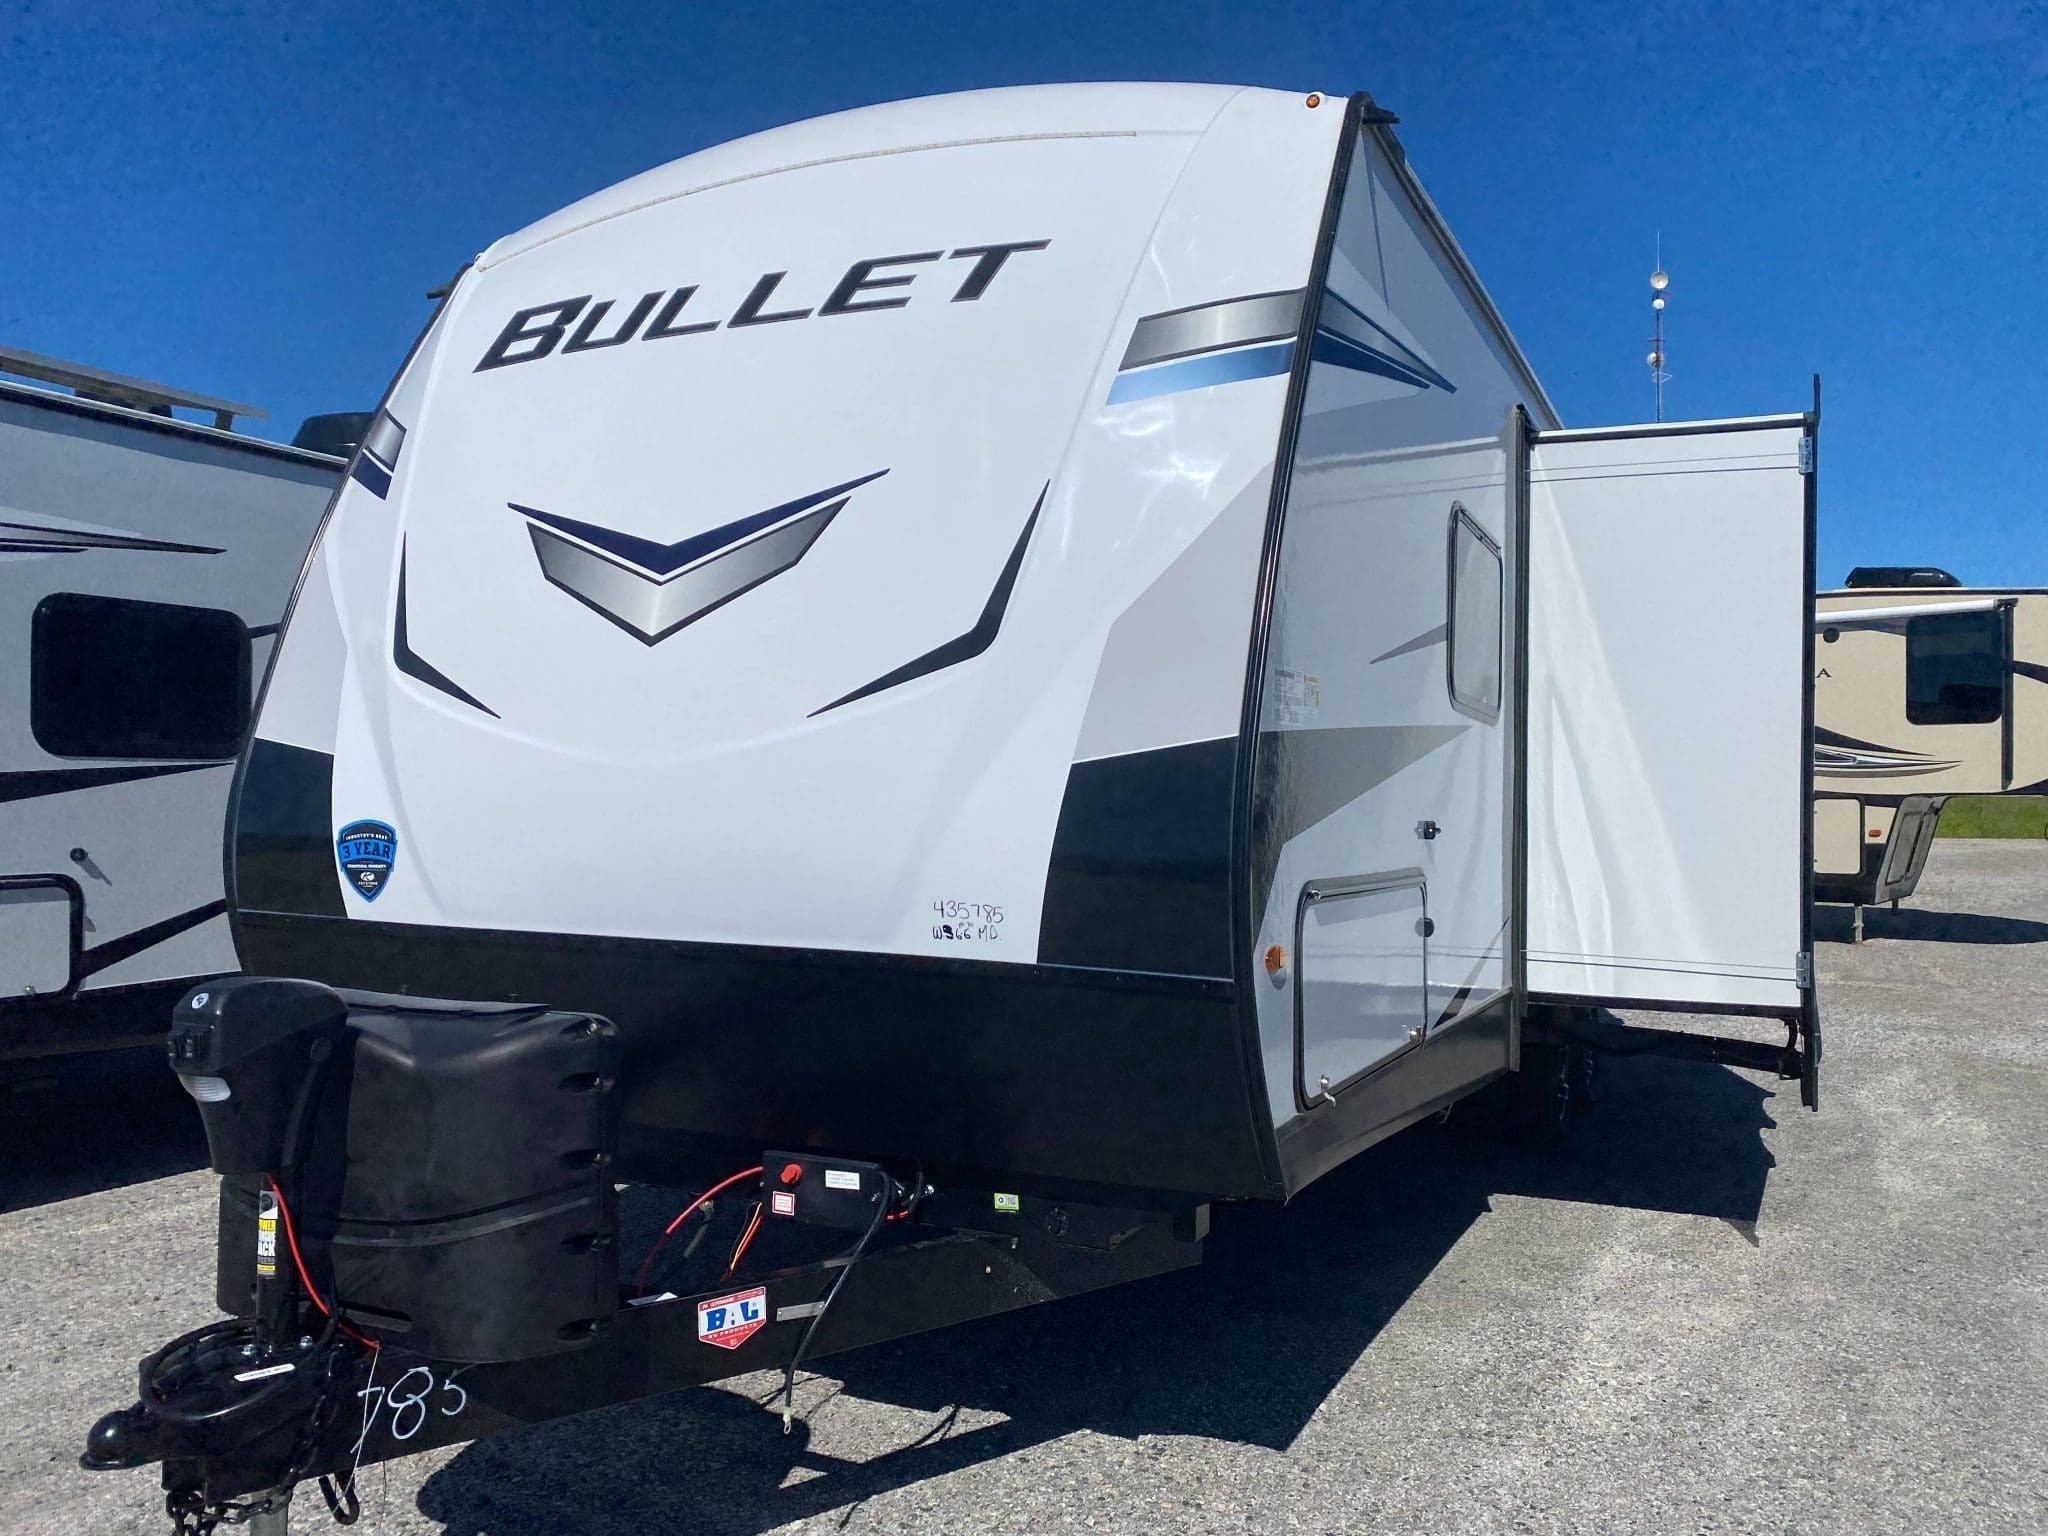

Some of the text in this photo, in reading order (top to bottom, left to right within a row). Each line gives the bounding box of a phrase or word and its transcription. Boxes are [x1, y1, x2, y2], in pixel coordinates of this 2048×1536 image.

[472, 238, 1052, 373] BULLET
[342, 841, 391, 859] 3 YEAR
[933, 900, 1004, 924] 435785
[706, 1301, 759, 1332] BAL
[350, 1366, 467, 1454] 785
